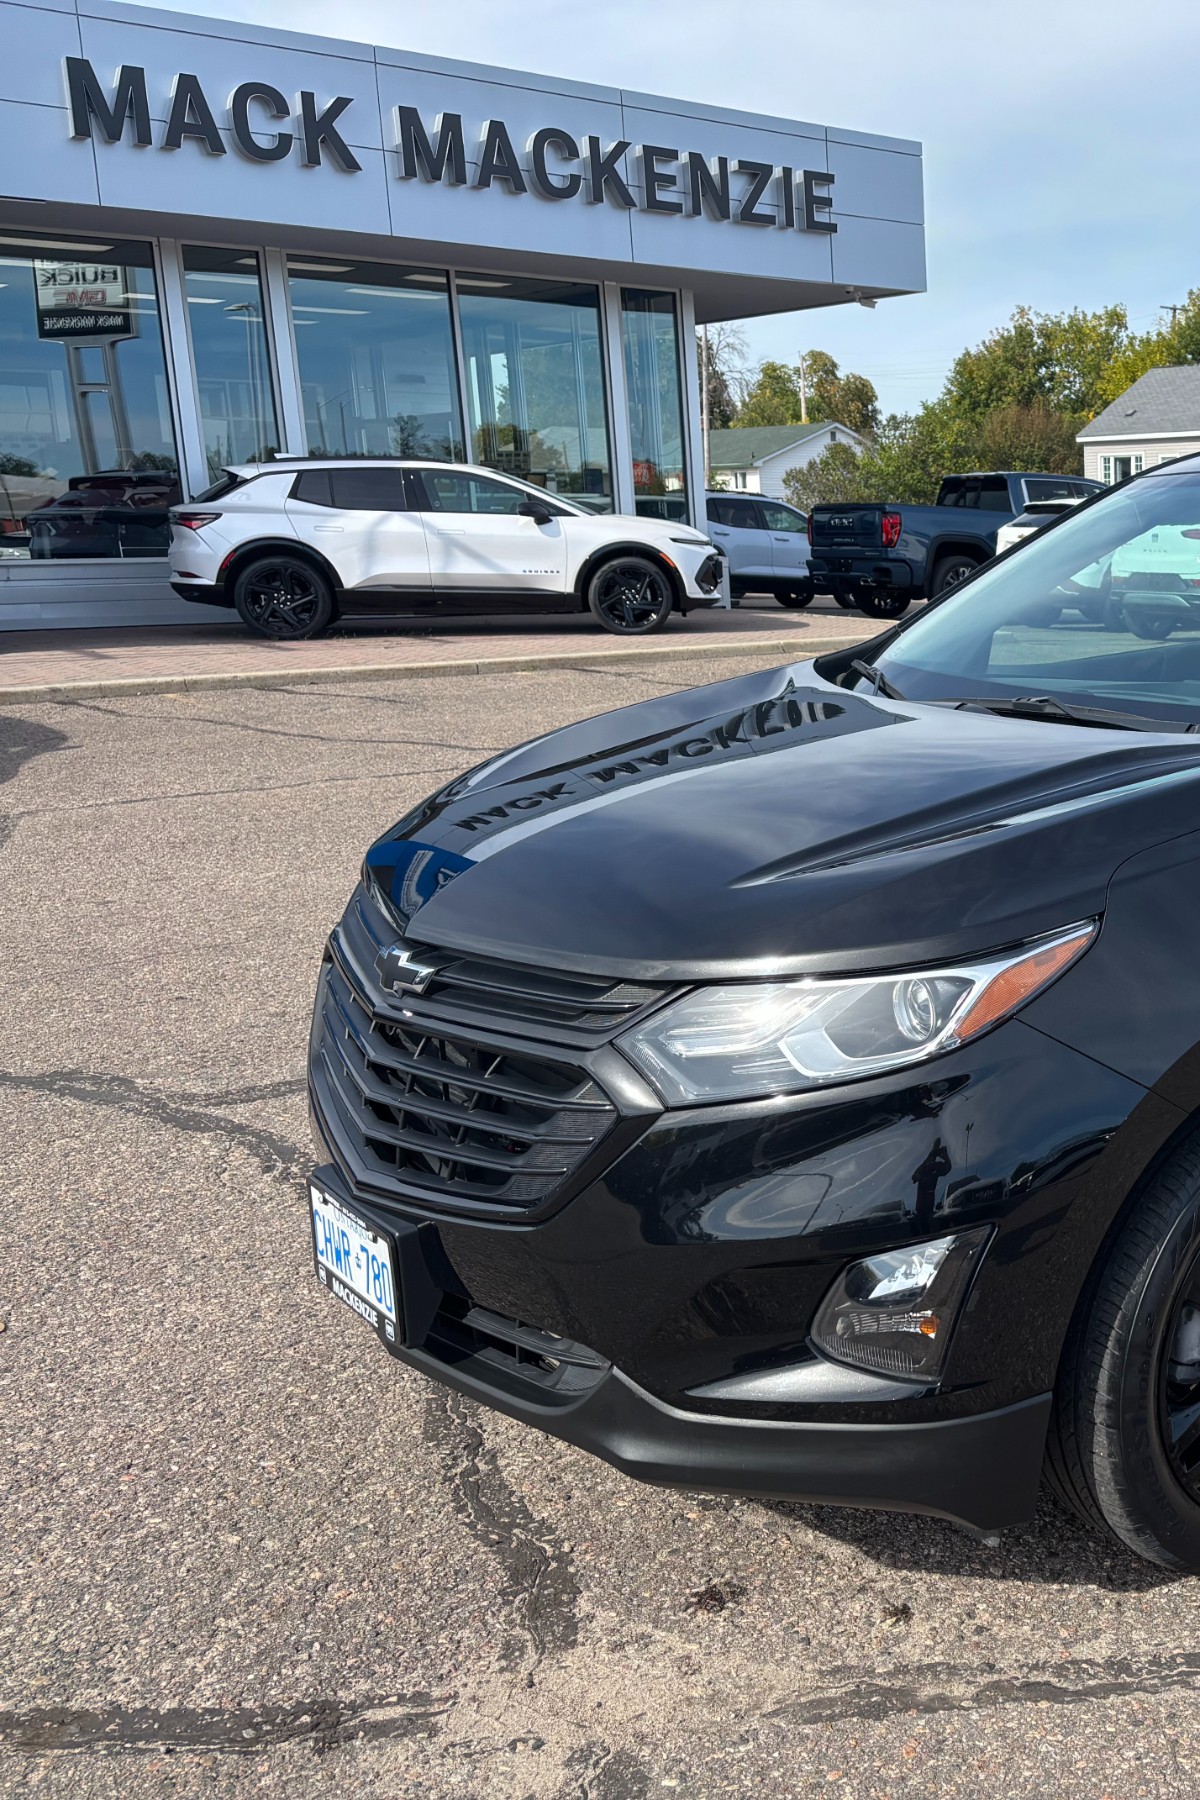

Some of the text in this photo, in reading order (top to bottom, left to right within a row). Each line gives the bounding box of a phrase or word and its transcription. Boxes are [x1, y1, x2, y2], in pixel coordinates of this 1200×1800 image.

[63, 56, 838, 233] MACK MACKENZIE
[314, 1209, 353, 1281] CHWR
[360, 1244, 393, 1313] 780
[332, 1276, 379, 1328] MACKENZIE
